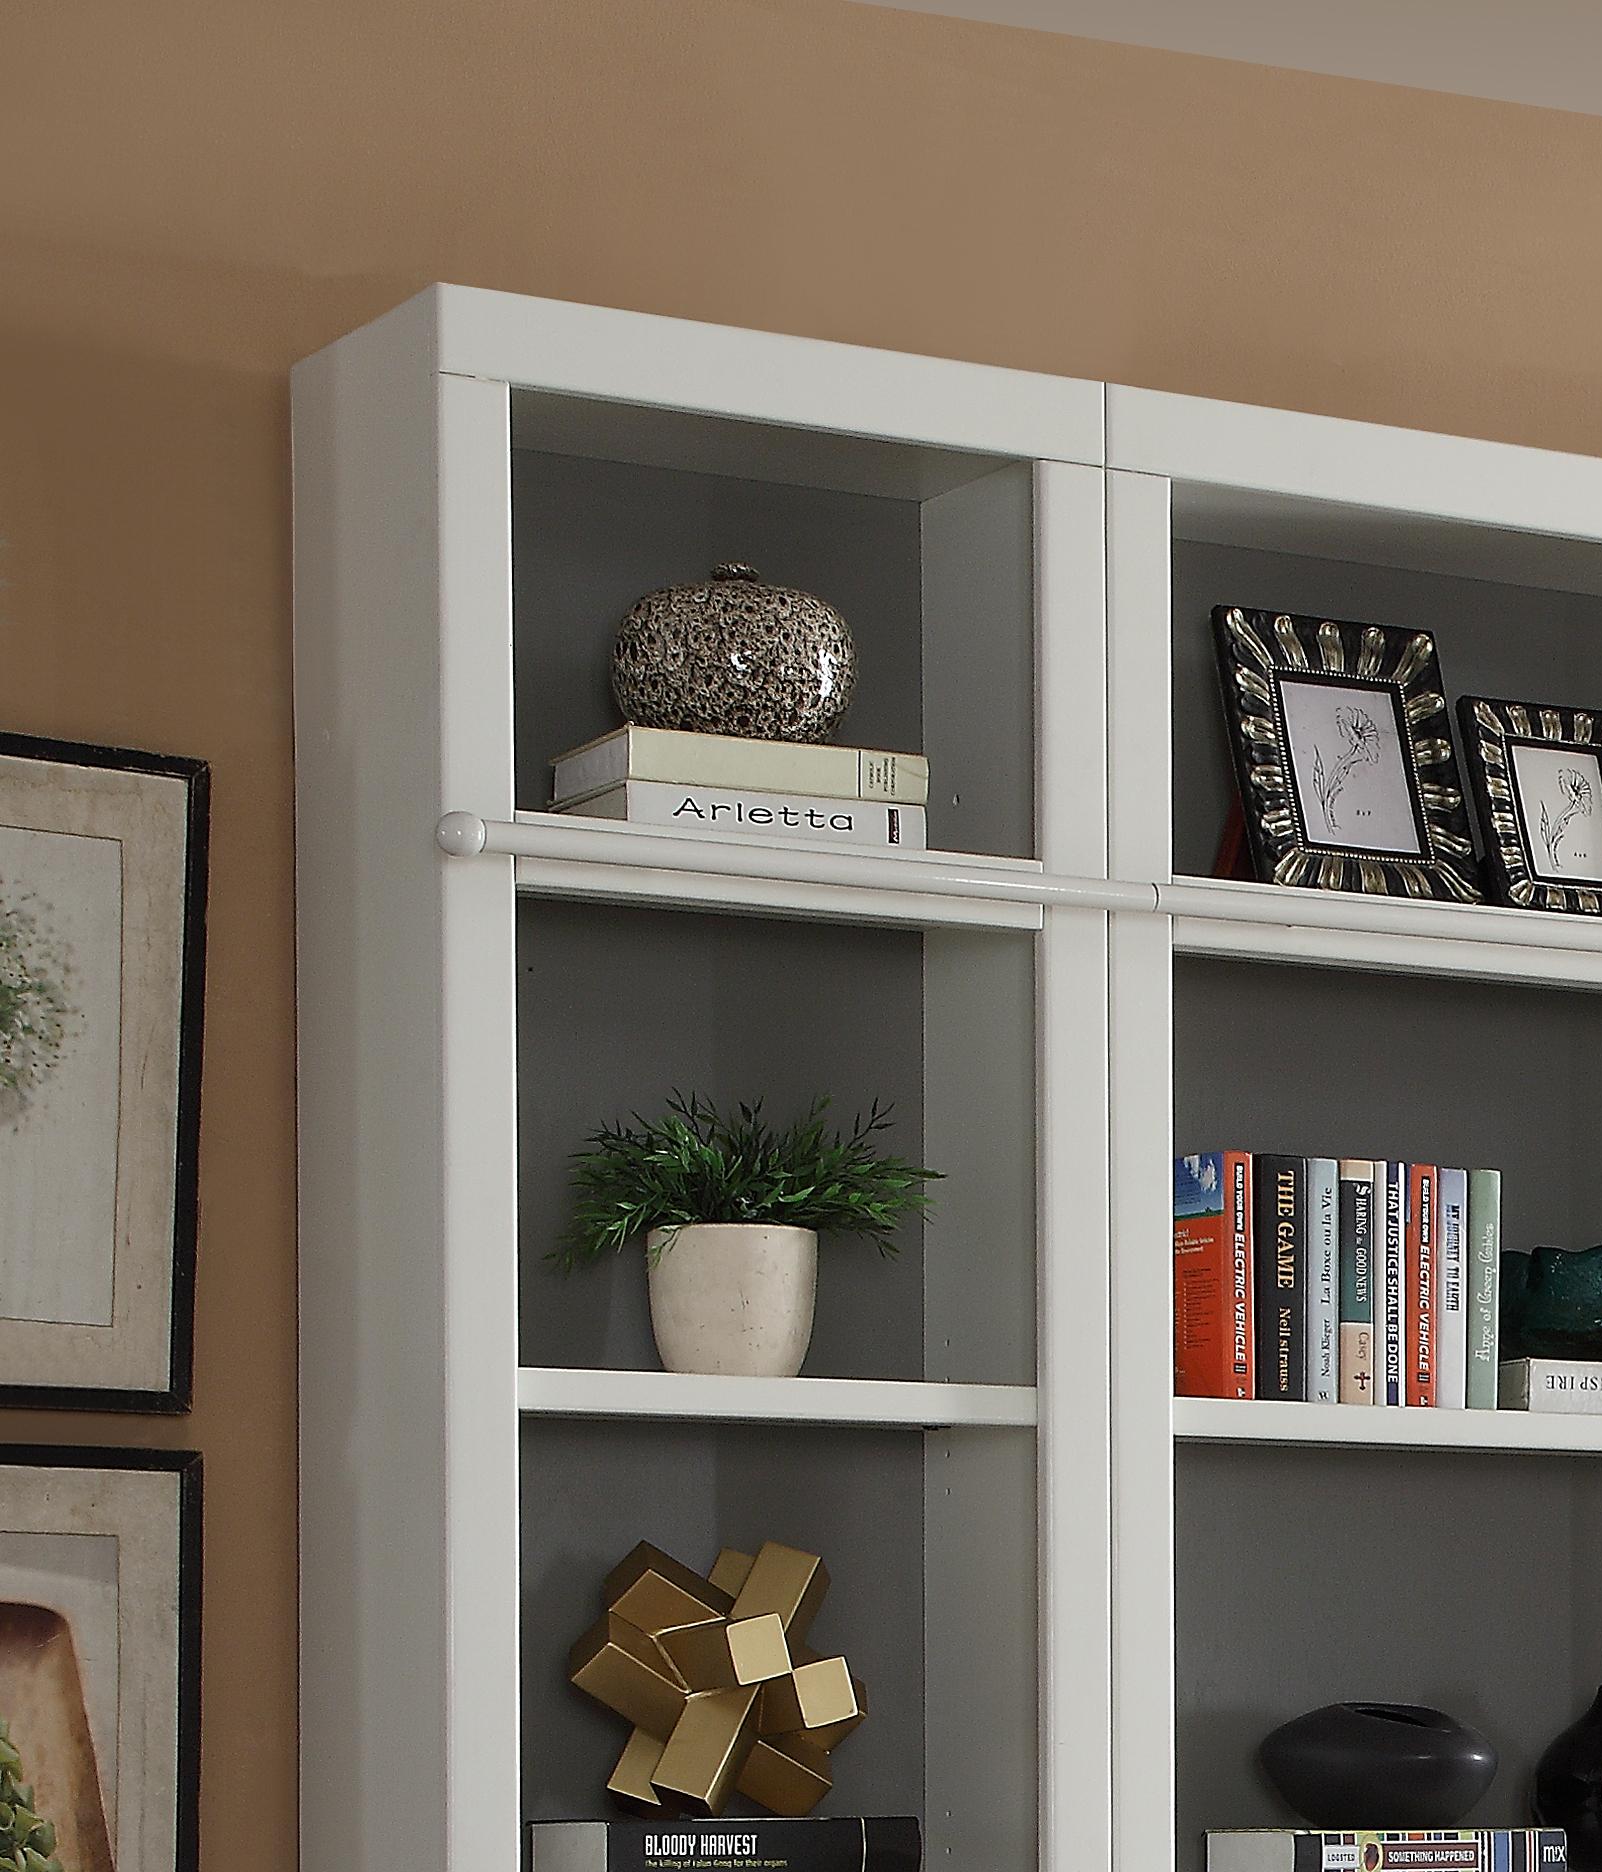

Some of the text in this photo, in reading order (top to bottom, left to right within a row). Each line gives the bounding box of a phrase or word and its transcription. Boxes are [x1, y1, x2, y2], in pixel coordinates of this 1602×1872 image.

[672, 797, 853, 831] Arletta
[1277, 1171, 1294, 1289] THE GAME
[1321, 1187, 1332, 1305] La Boxe ou la Vie
[1355, 1183, 1370, 1303] SHARING GOOD NEWS
[1388, 1182, 1397, 1383] THAT JUSTICE SHALL BE DONE
[1446, 1204, 1459, 1311] MY TO EARTH
[1235, 1234, 1246, 1361] ELECTRIC VEHICLE
[1358, 1332, 1369, 1361] Casey
[1419, 1245, 1430, 1370] ELECTRIC VEHICLE
[1475, 1223, 1496, 1361] Anne Green Gables
[1279, 1307, 1291, 1392] Neil strauss
[1321, 1352, 1331, 1377] Noah
[645, 1834, 758, 1856] BLOODY HARVEST
[1388, 1850, 1475, 1863] SOMETHING HAPPENED
